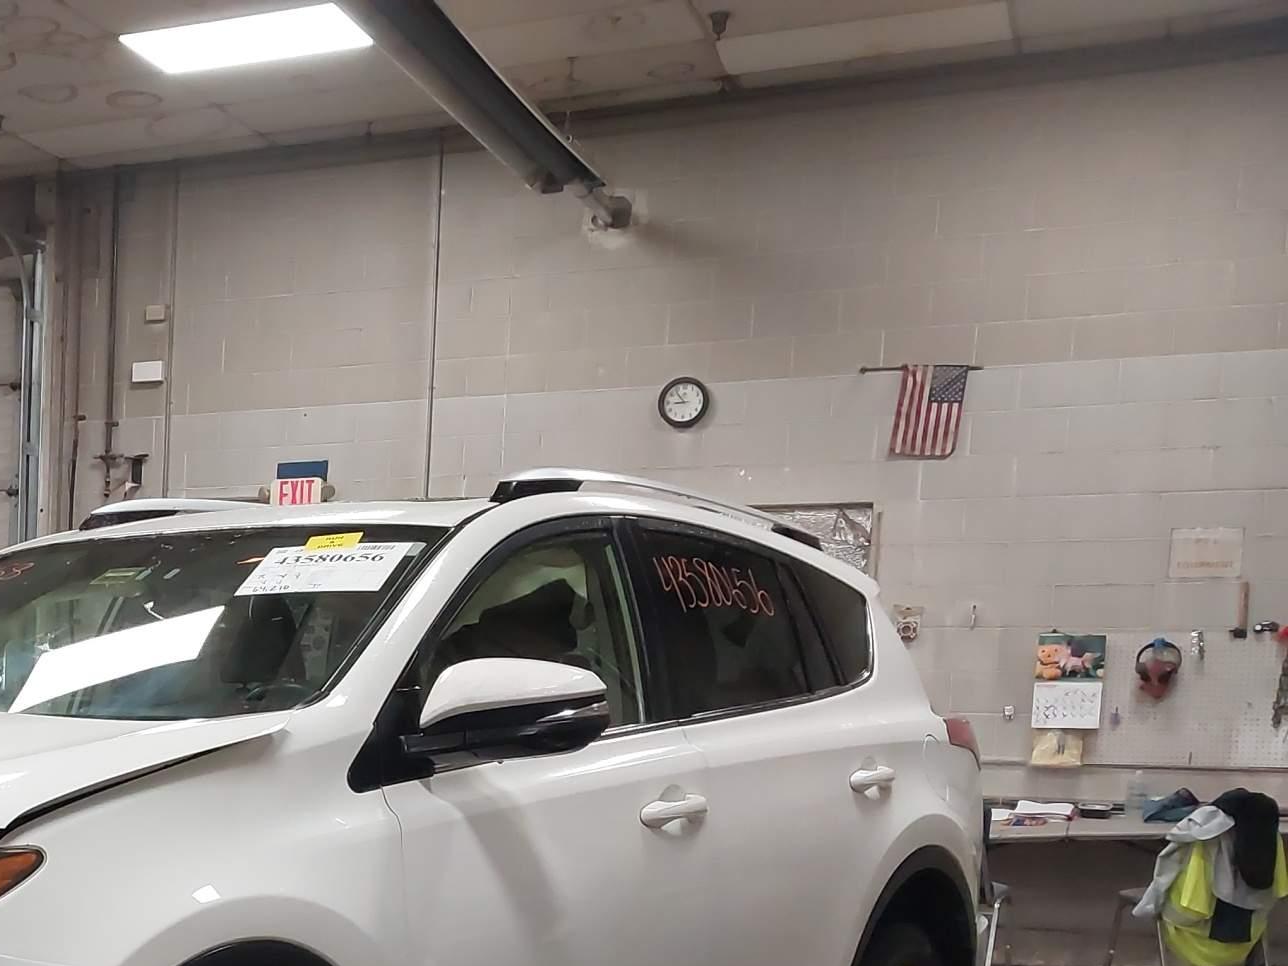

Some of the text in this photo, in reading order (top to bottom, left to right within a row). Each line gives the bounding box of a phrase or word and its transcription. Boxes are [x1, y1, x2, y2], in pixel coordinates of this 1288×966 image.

[279, 479, 315, 505] EXIT
[274, 552, 385, 565] 43580656
[652, 555, 775, 616] 43580656
